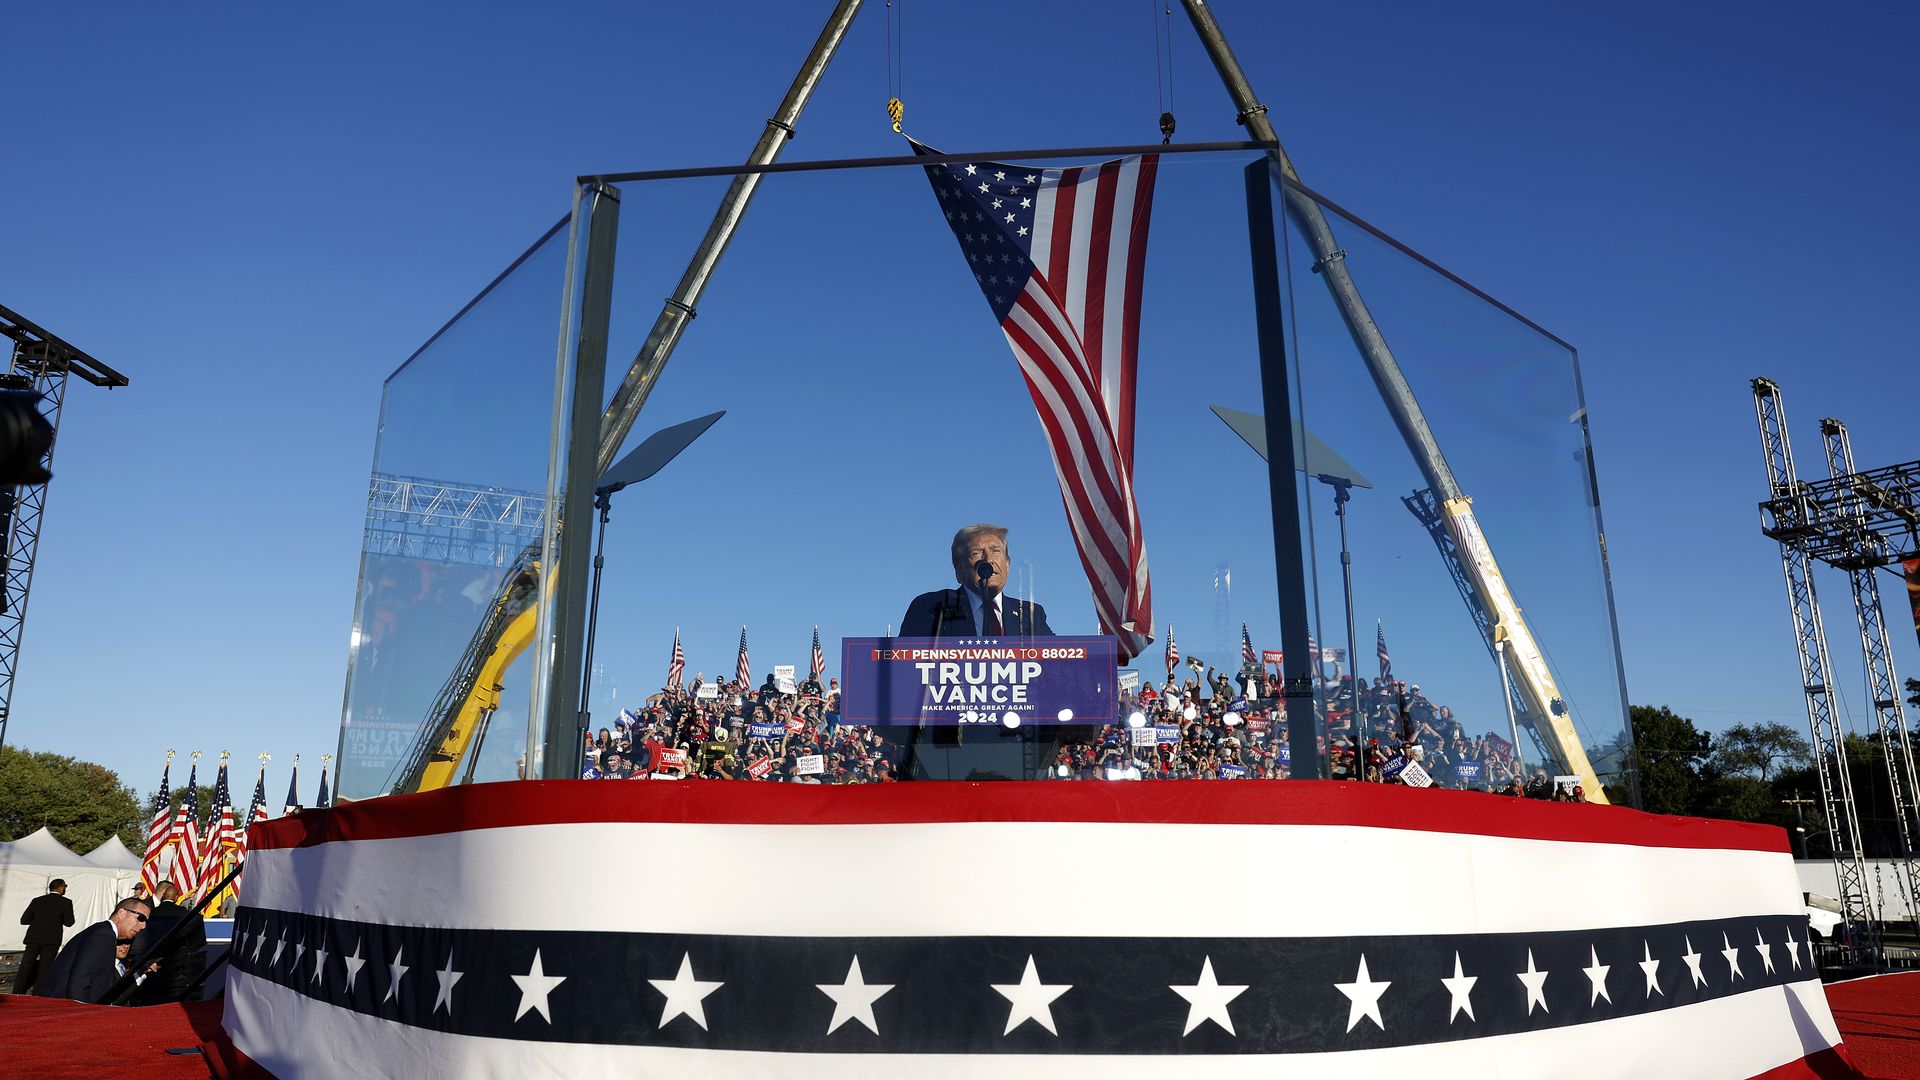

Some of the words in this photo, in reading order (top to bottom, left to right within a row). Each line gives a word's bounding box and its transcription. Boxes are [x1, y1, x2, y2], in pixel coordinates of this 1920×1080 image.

[874, 649, 909, 660] TEXT
[912, 648, 1016, 660] PENNSYLVANIA
[1020, 648, 1038, 659] TO
[1041, 648, 1084, 659] 88022
[915, 661, 1043, 685] TRUMP
[929, 685, 1028, 704] VANCE
[751, 725, 773, 733] TRUMP
[1408, 769, 1426, 786] FIGHT!
[1412, 765, 1429, 783] FIGHT!
